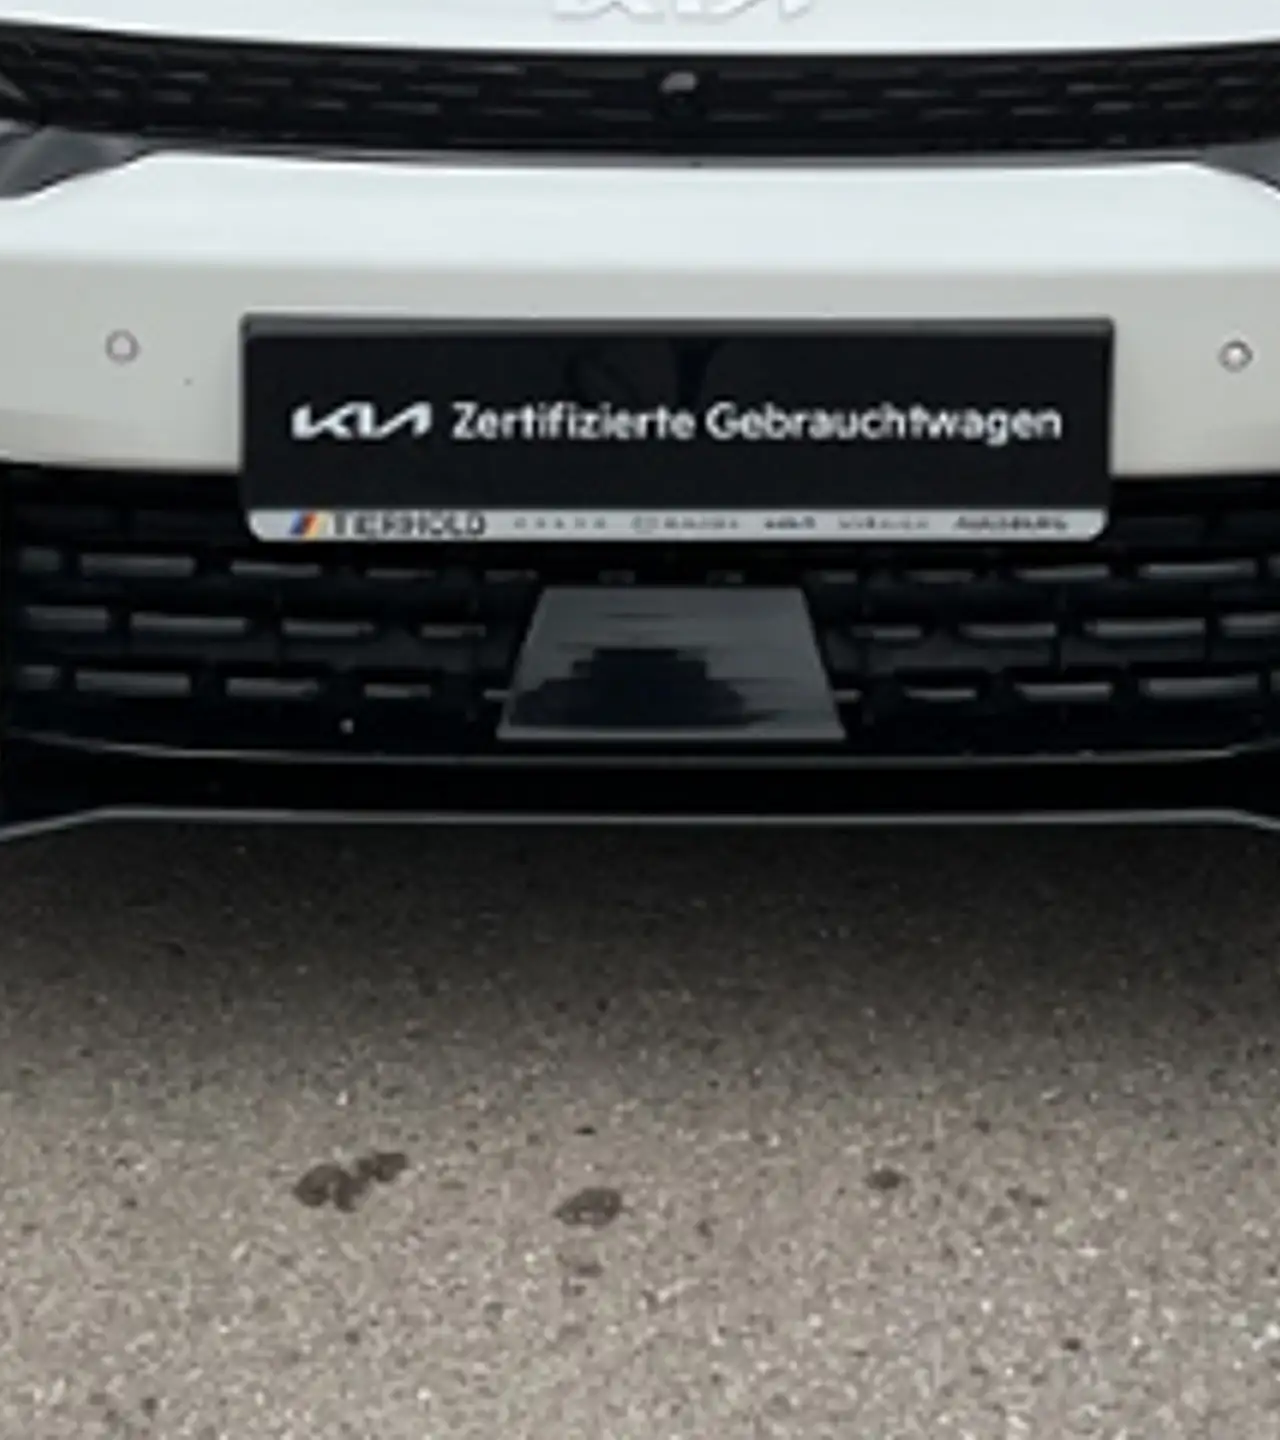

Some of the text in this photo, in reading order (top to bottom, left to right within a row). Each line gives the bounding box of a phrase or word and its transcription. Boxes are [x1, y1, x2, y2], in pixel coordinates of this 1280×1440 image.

[291, 400, 1062, 448] KIA Zertifizierte Gebrauchtwagen
